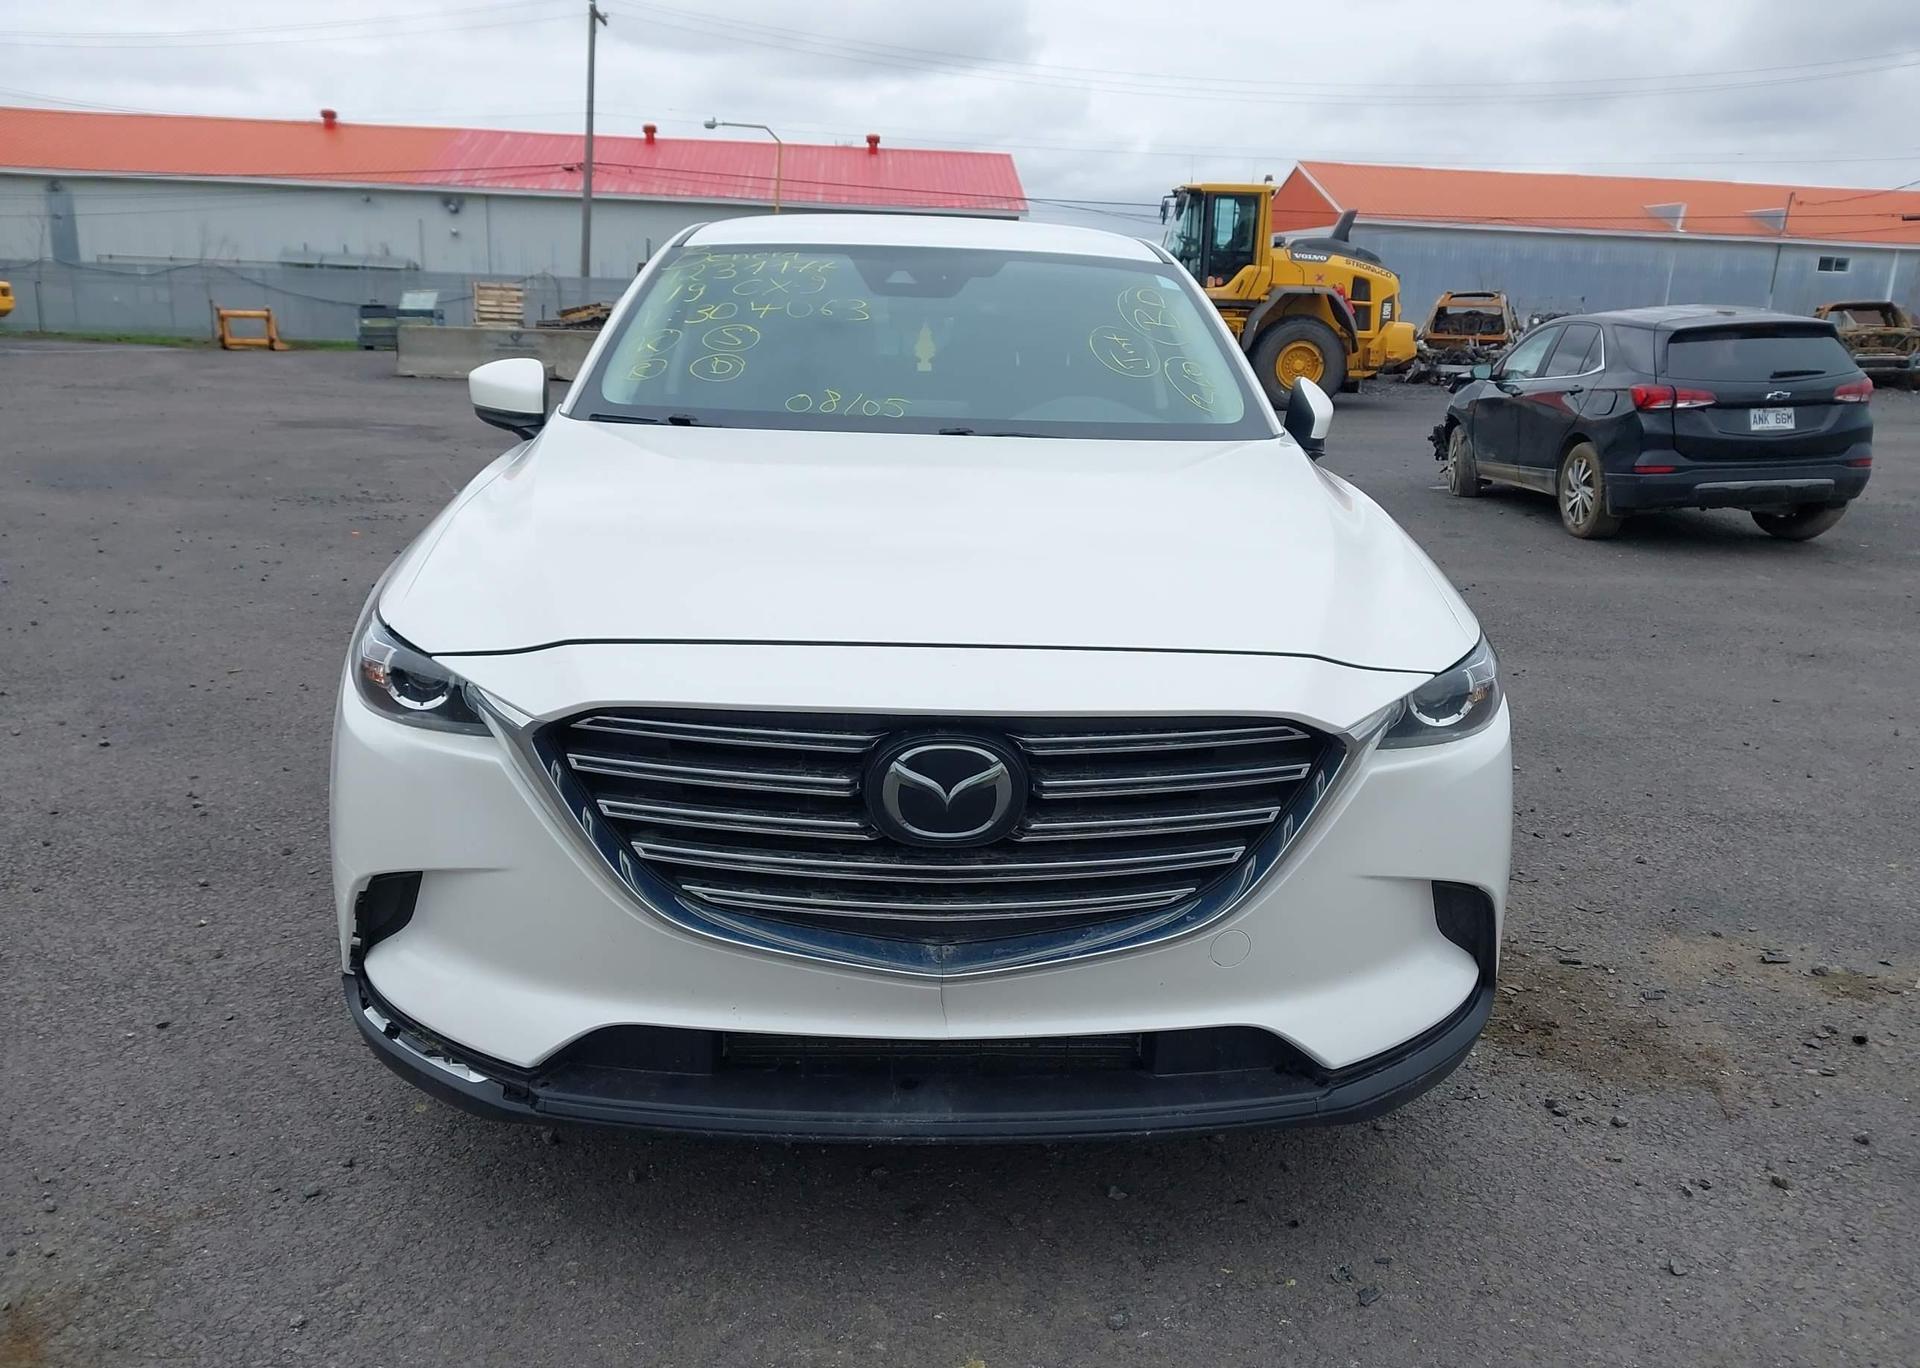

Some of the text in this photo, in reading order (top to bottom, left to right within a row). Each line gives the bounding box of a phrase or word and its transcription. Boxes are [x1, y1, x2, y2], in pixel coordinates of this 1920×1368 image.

[1293, 252, 1327, 261] VOLVO
[785, 389, 912, 418] 08/05
[1752, 413, 1770, 425] ANK
